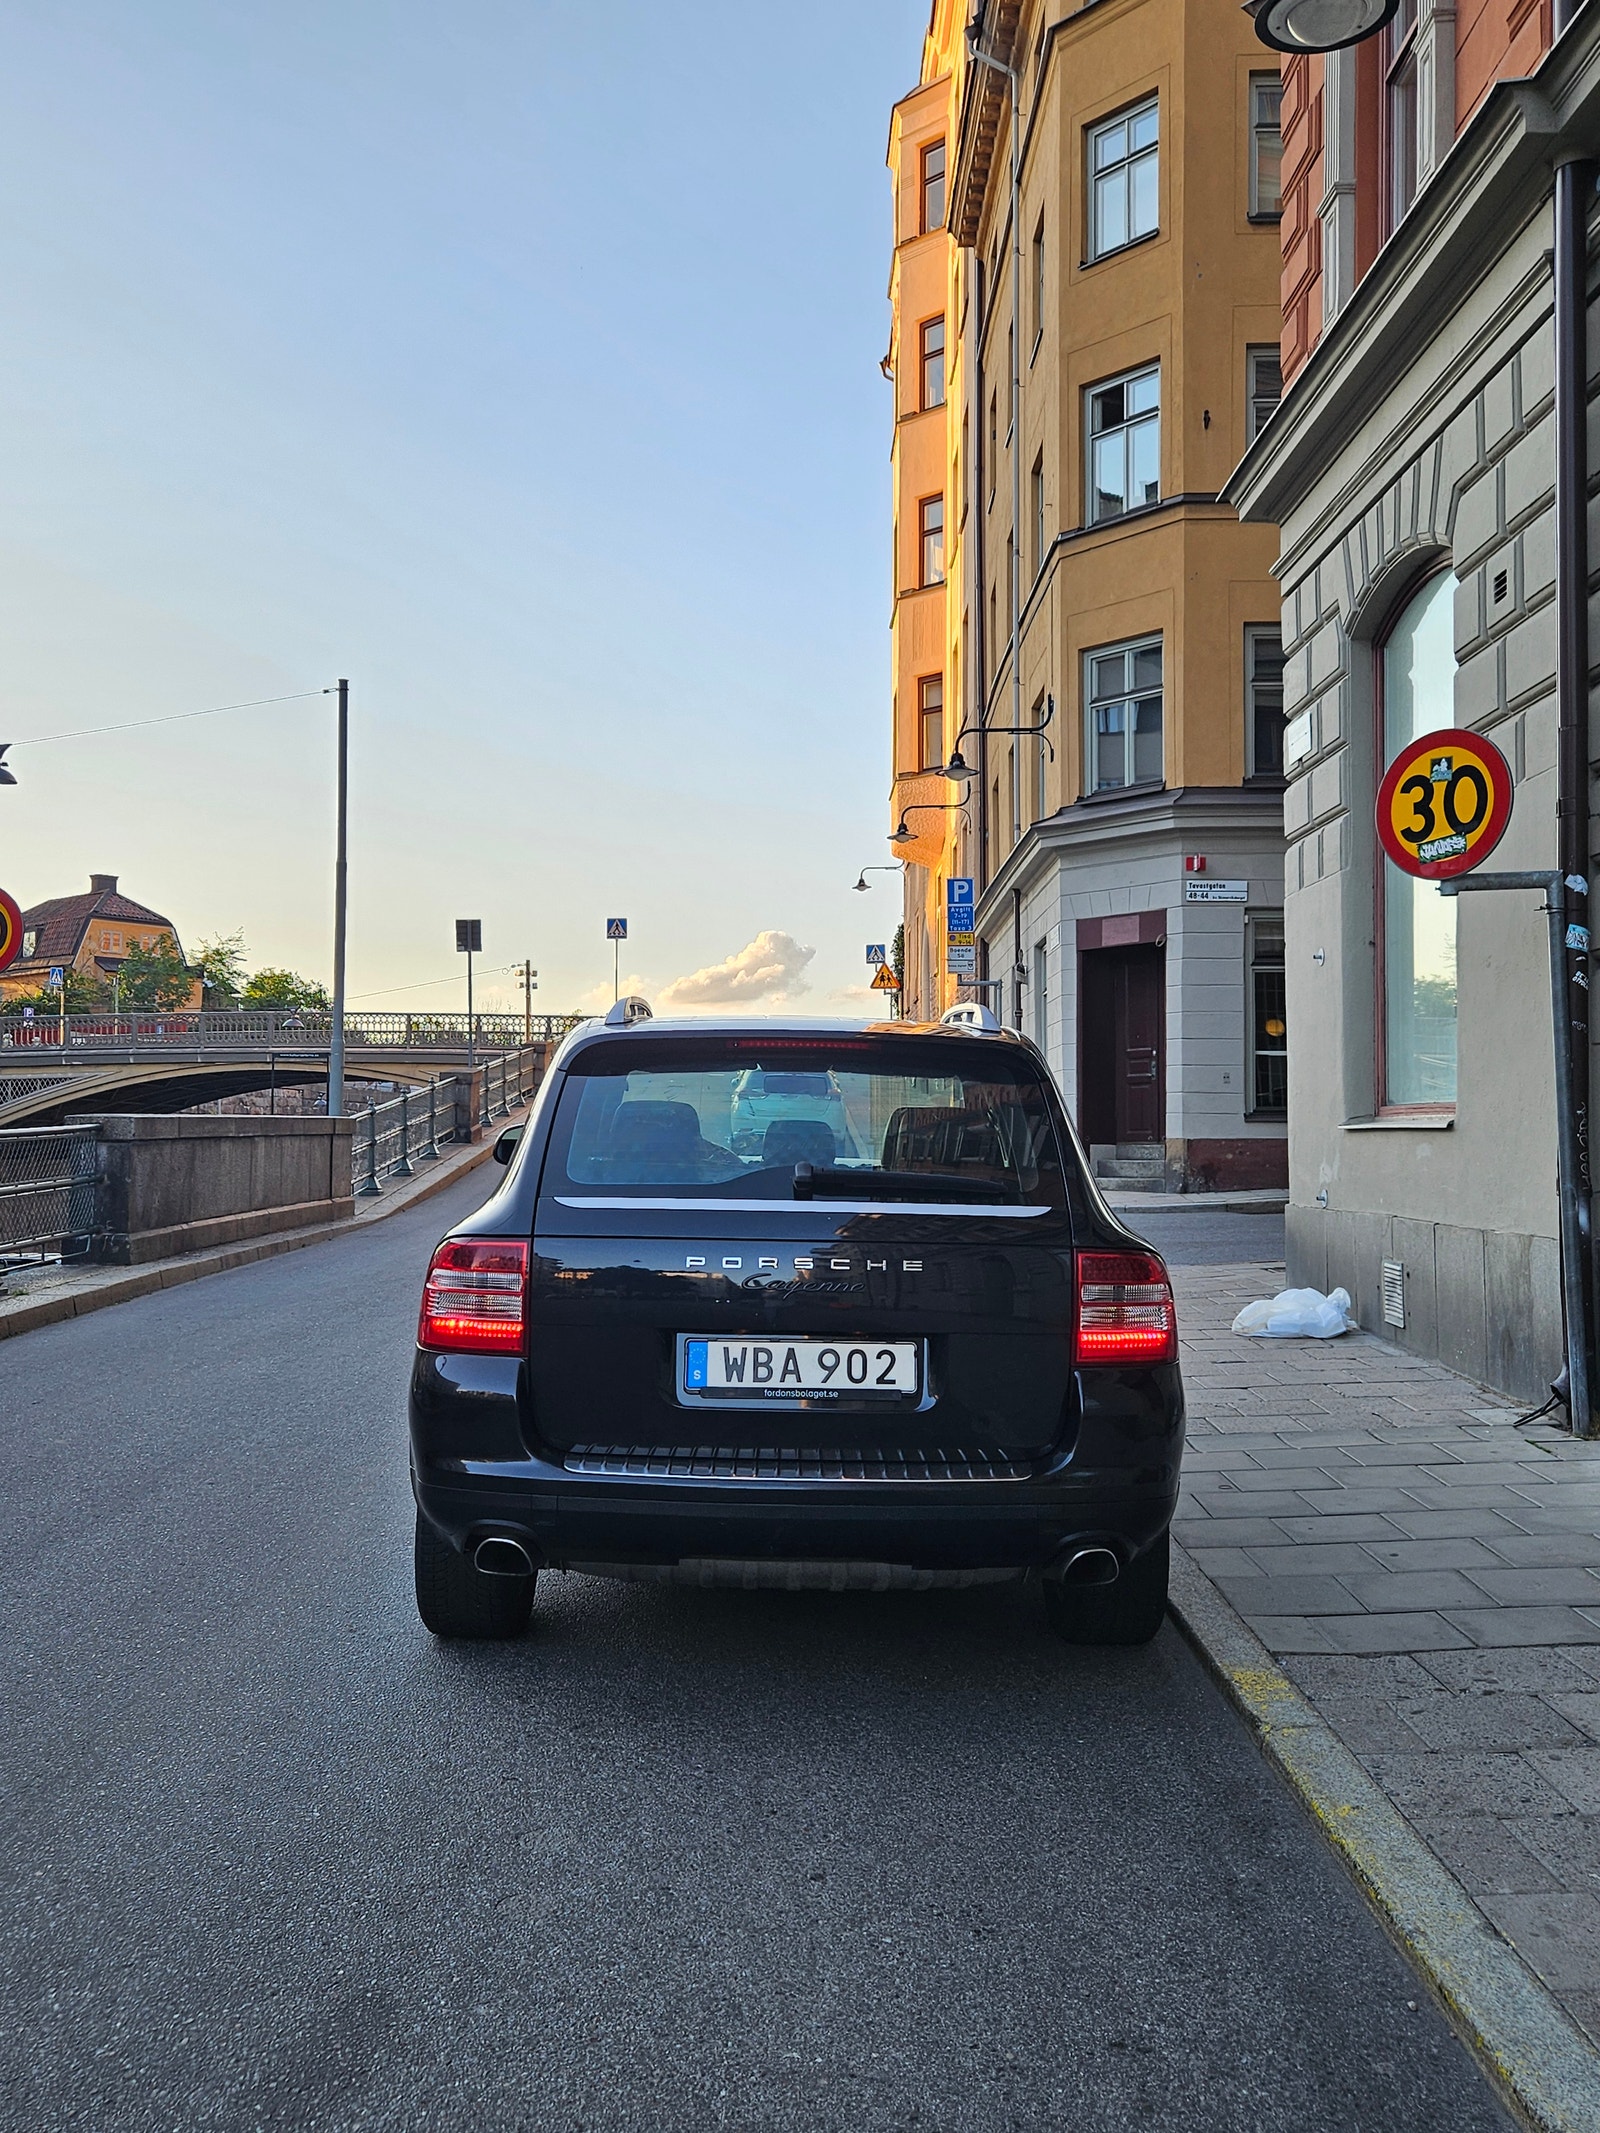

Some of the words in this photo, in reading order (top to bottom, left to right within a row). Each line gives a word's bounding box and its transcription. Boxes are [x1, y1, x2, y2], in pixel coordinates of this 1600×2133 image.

[1400, 765, 1489, 843] 30
[954, 881, 969, 902] P
[685, 1256, 923, 1272] PORSCHE
[741, 1272, 866, 1300] Cayenne
[693, 1370, 701, 1381] S
[723, 1346, 803, 1384] WBA
[817, 1348, 897, 1385] 902
[764, 1388, 839, 1399] fordonsbolaget.se
